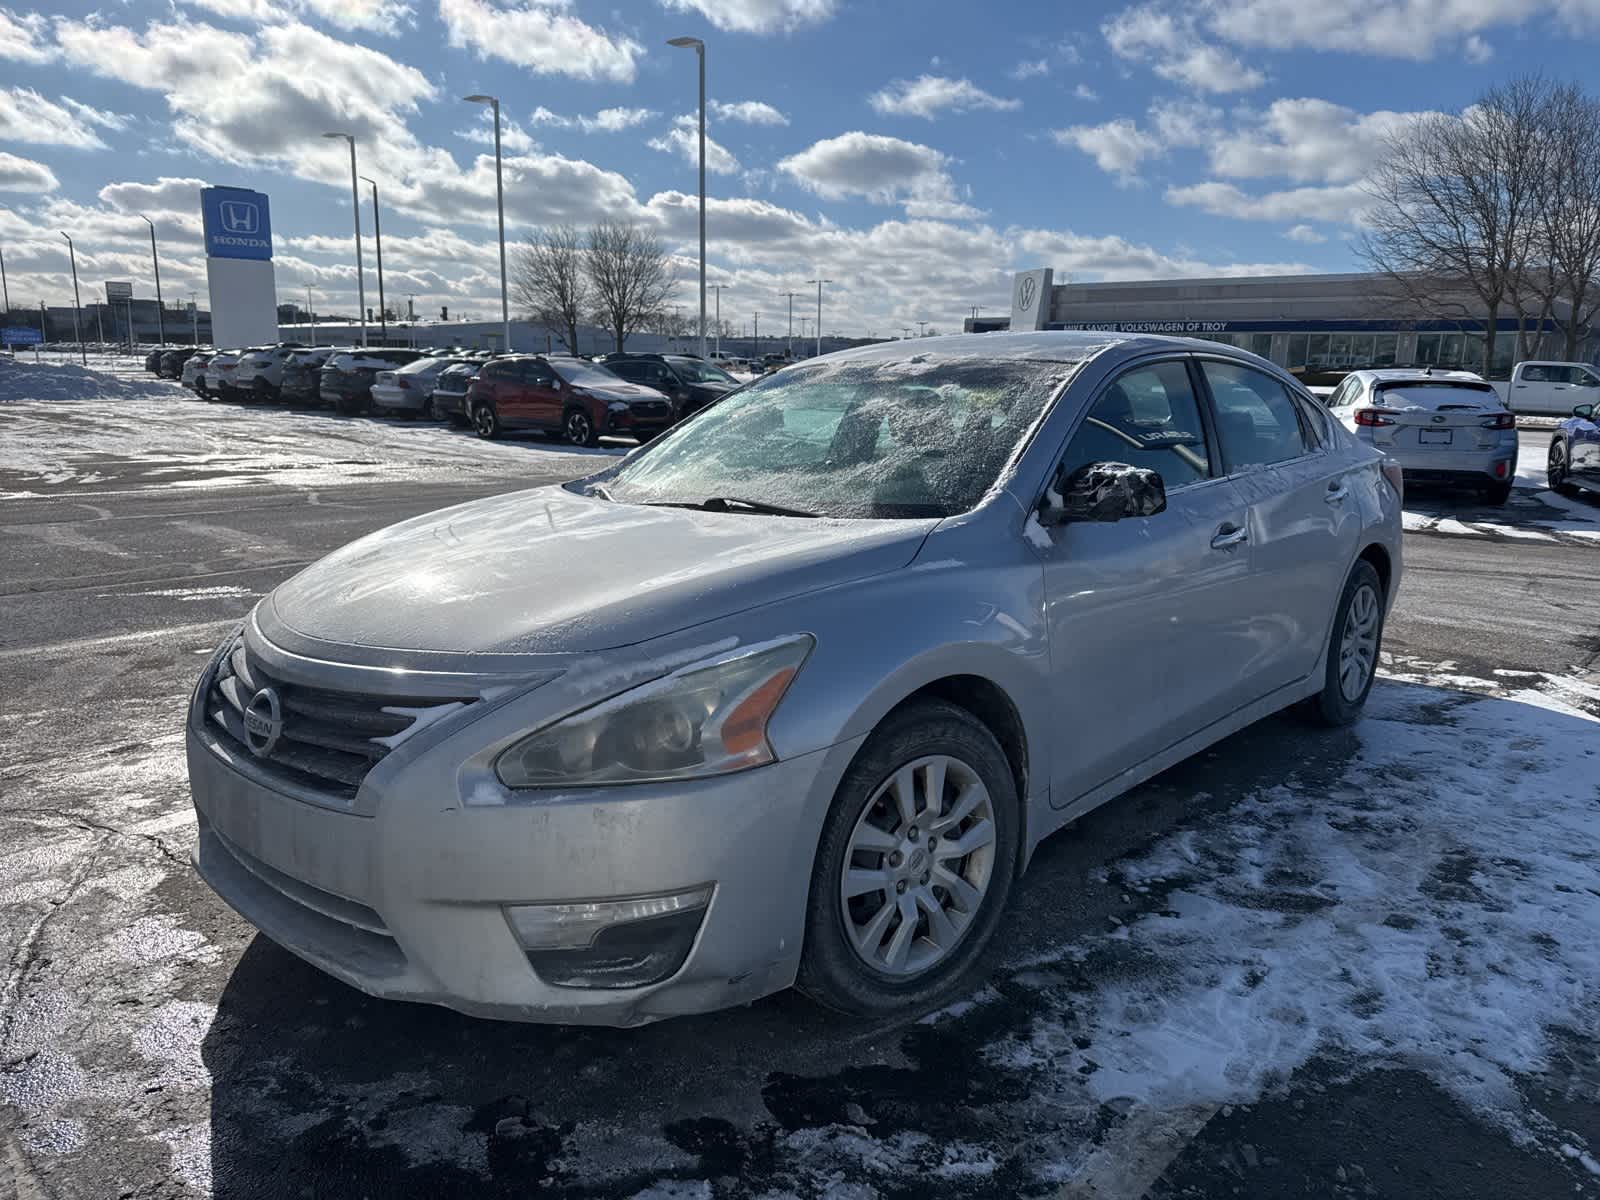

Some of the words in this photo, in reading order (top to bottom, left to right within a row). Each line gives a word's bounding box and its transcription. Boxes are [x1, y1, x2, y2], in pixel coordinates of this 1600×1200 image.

[213, 235, 270, 248] HONDA
[1086, 324, 1118, 332] SAVOIE
[1119, 322, 1184, 332] VOLKSWAGEN
[1186, 322, 1201, 331] OF
[1202, 322, 1228, 331] TROY
